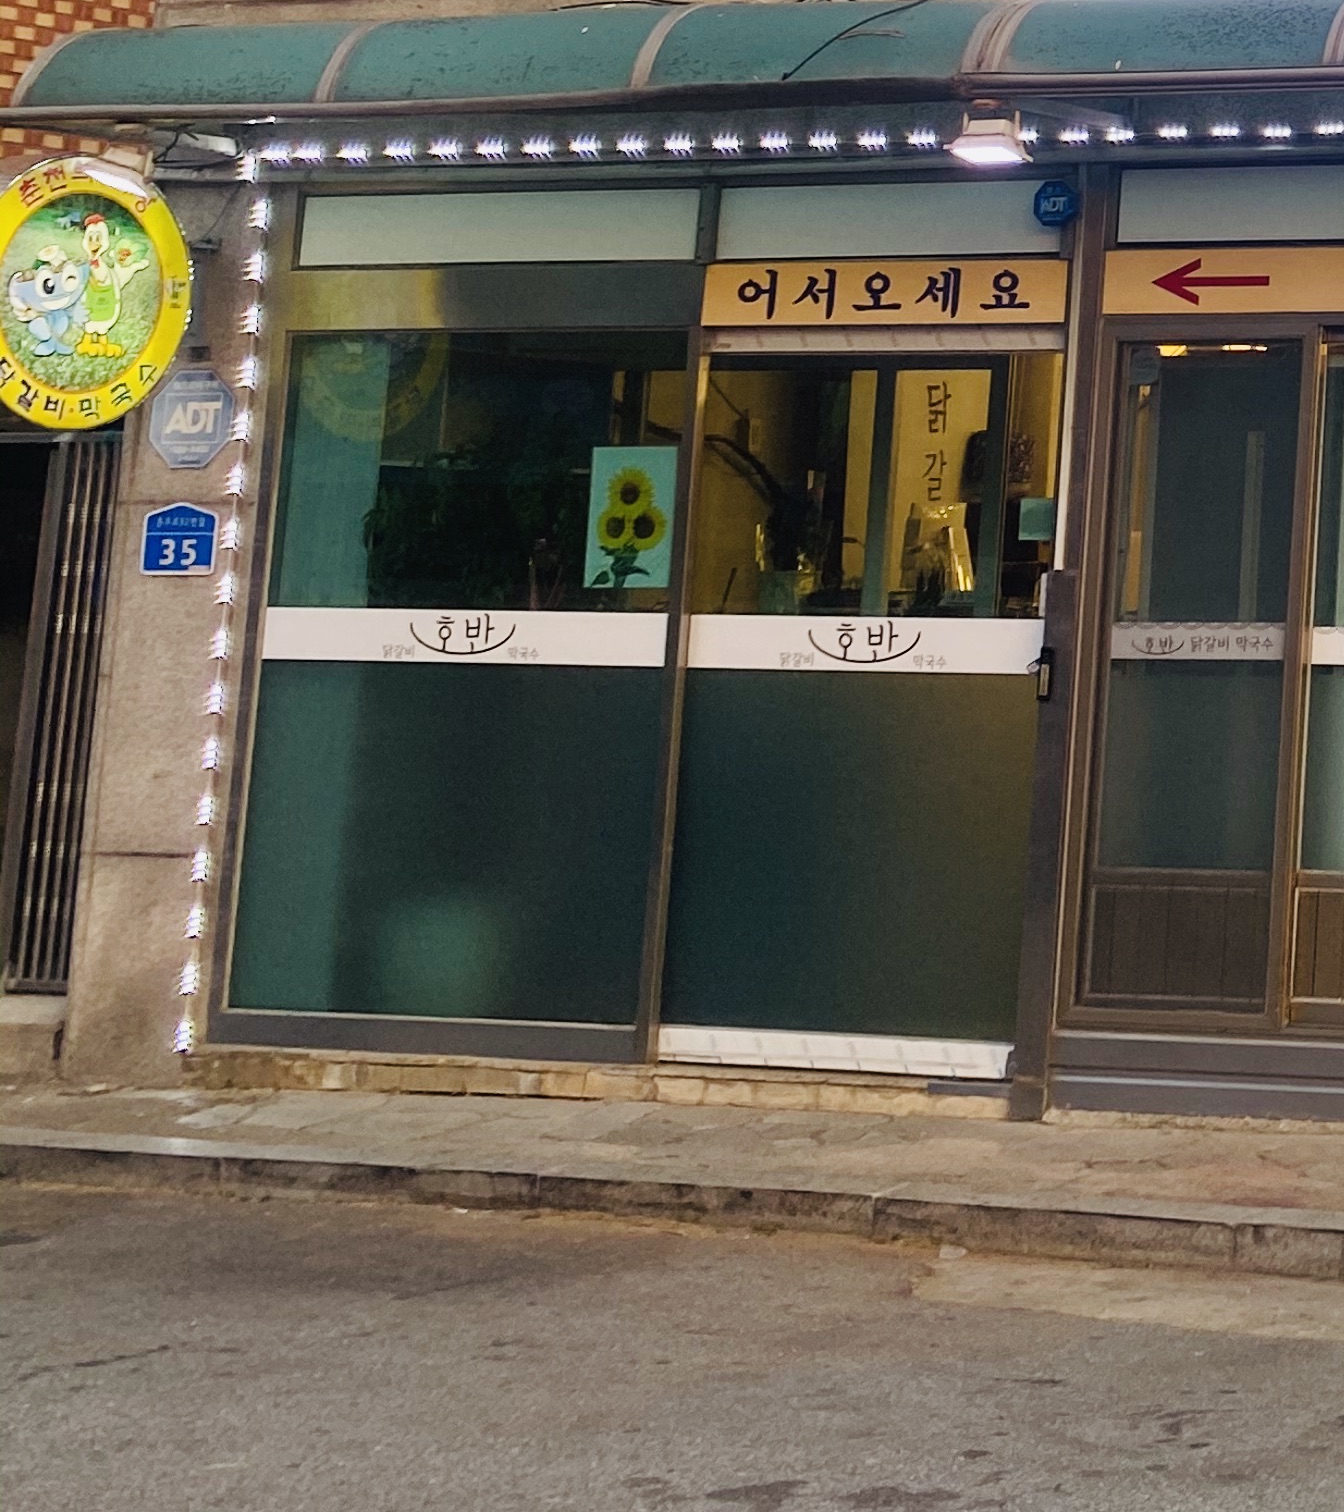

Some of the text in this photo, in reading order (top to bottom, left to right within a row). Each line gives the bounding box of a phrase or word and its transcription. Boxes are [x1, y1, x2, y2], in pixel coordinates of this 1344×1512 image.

[737, 267, 1031, 320] 어서오세요
[164, 401, 222, 434] ADT
[159, 539, 197, 566] 35
[436, 613, 495, 655] 호반
[836, 620, 899, 663] 호반
[1145, 635, 1275, 655] 호반 닭갈비 막국수
